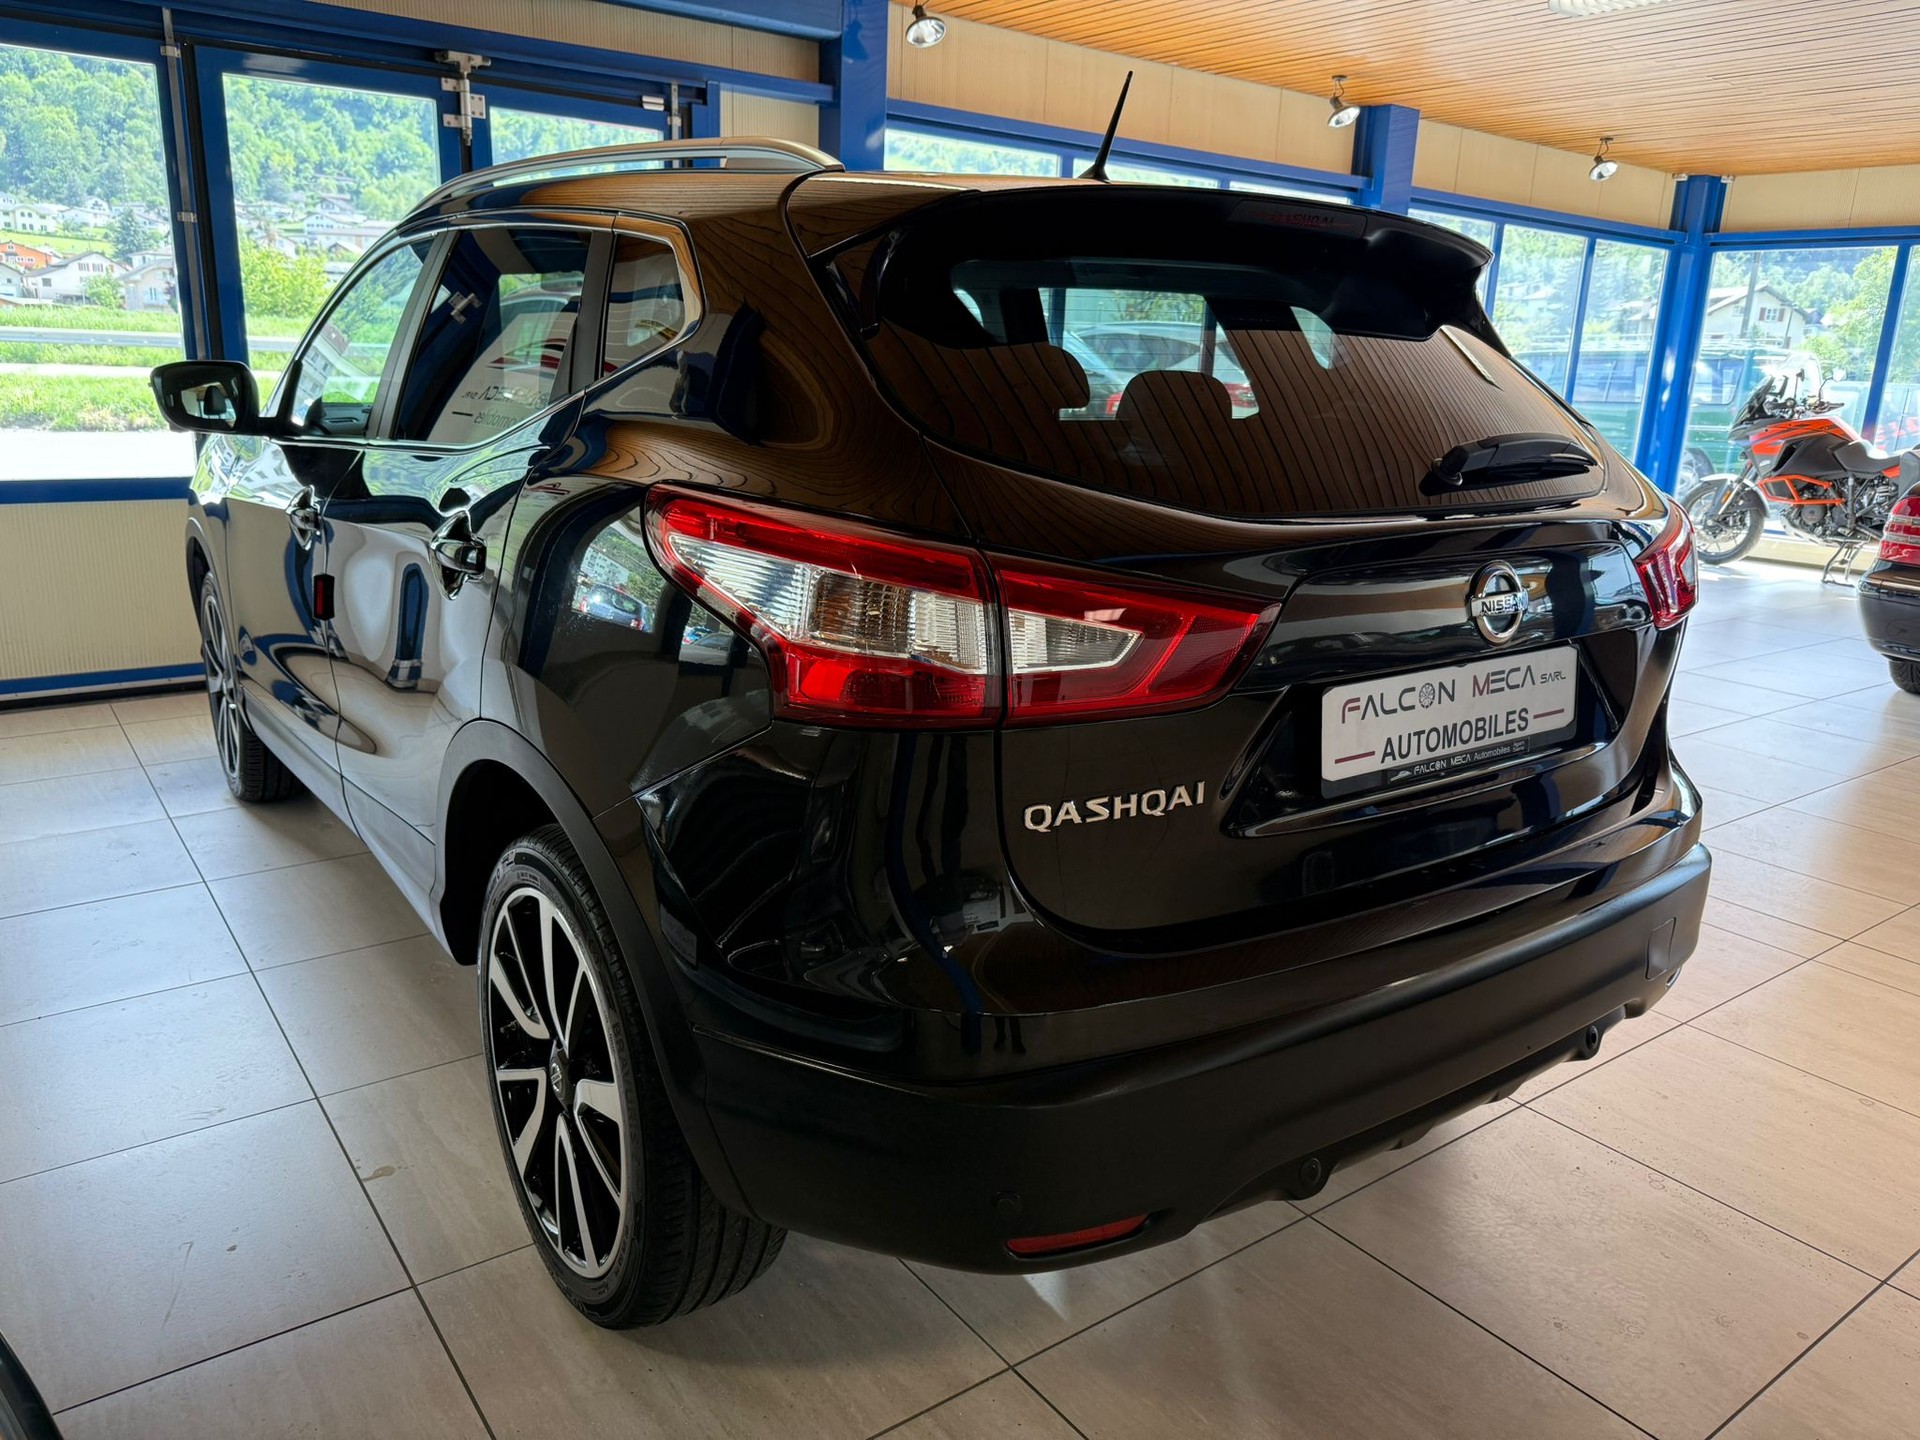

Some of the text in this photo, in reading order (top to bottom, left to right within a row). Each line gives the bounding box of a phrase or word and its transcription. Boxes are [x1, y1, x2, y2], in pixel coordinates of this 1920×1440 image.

[1481, 593, 1525, 613] NISSAN
[1341, 665, 1566, 724] FALCON MECA SARL
[1380, 707, 1529, 764] AUTOMOBILES
[1413, 760, 1447, 775] FALCON
[1450, 754, 1471, 767] MECA
[1474, 746, 1511, 761] Automobiles
[1024, 781, 1205, 833] QASHQAI
